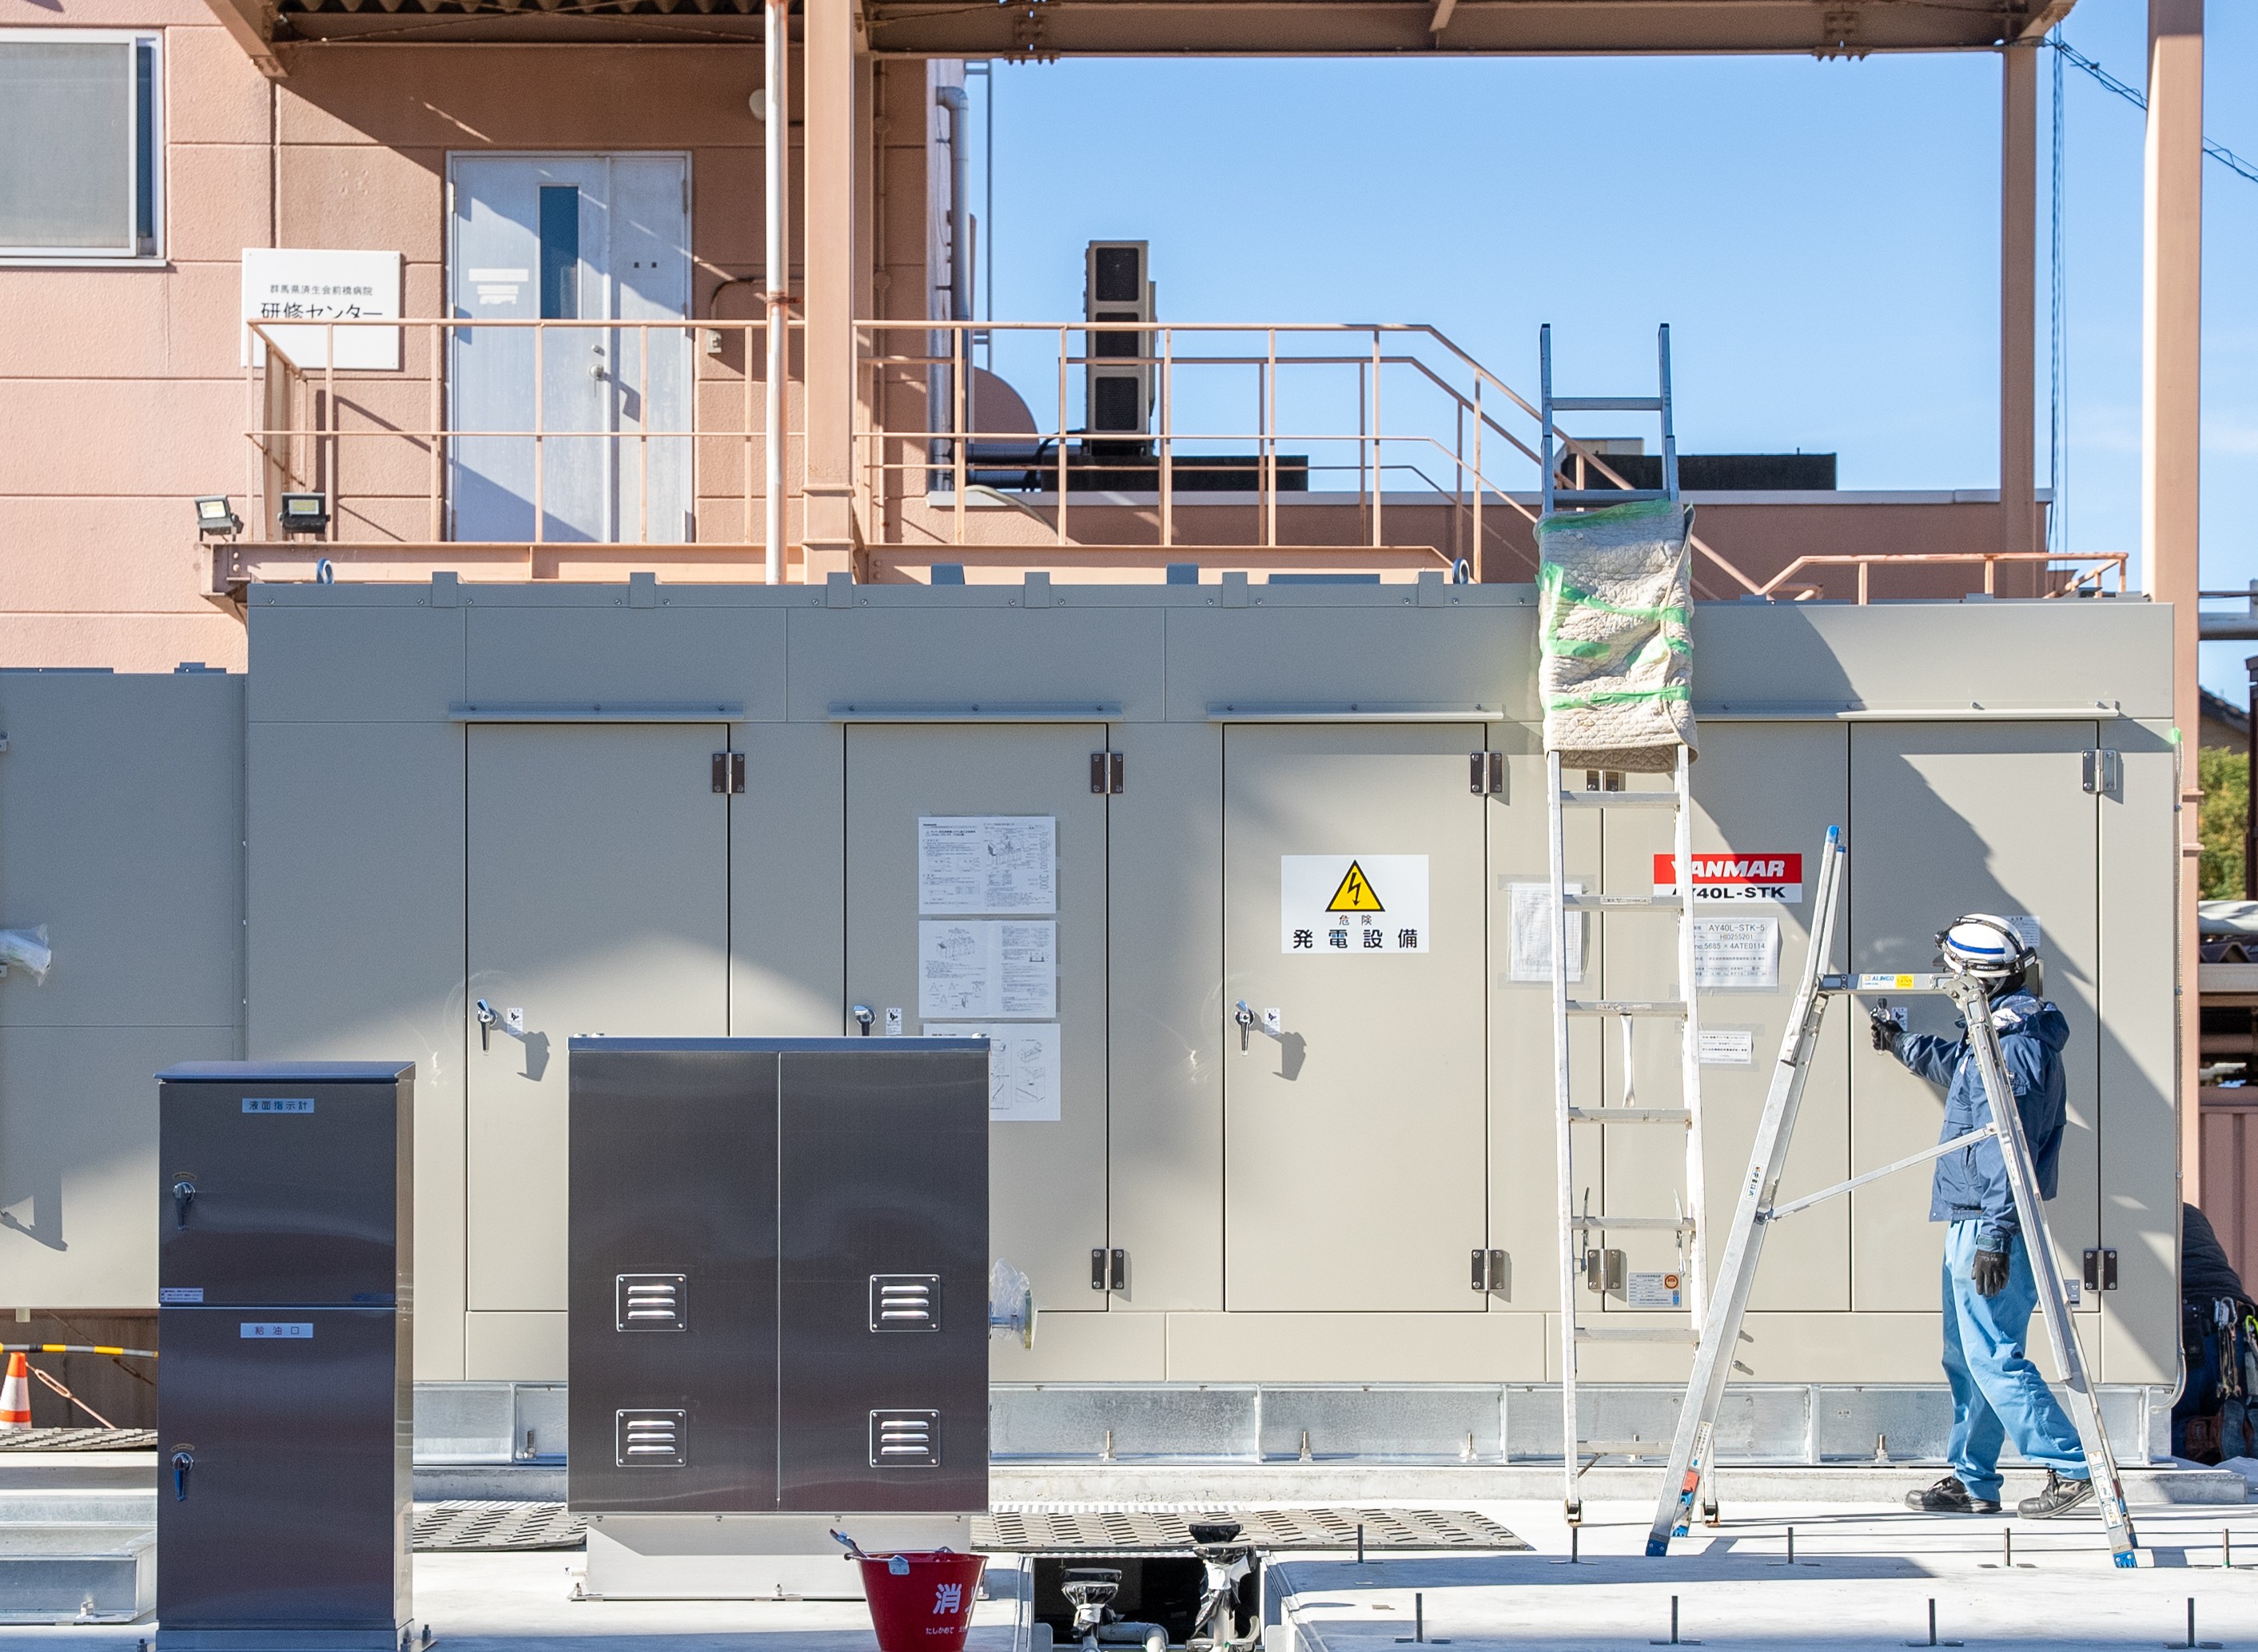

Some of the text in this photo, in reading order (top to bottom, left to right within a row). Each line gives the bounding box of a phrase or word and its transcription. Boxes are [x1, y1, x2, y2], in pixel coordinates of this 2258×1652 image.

[270, 285, 372, 296] 群馬県済生会前橋病院
[261, 302, 383, 319] 研修センター
[1672, 886, 1786, 899] 40L-STK
[1339, 914, 1372, 926] 危険
[1293, 928, 1418, 949] 発電設備
[249, 1101, 308, 1110] 液面指示計
[254, 1326, 299, 1336] 給油口
